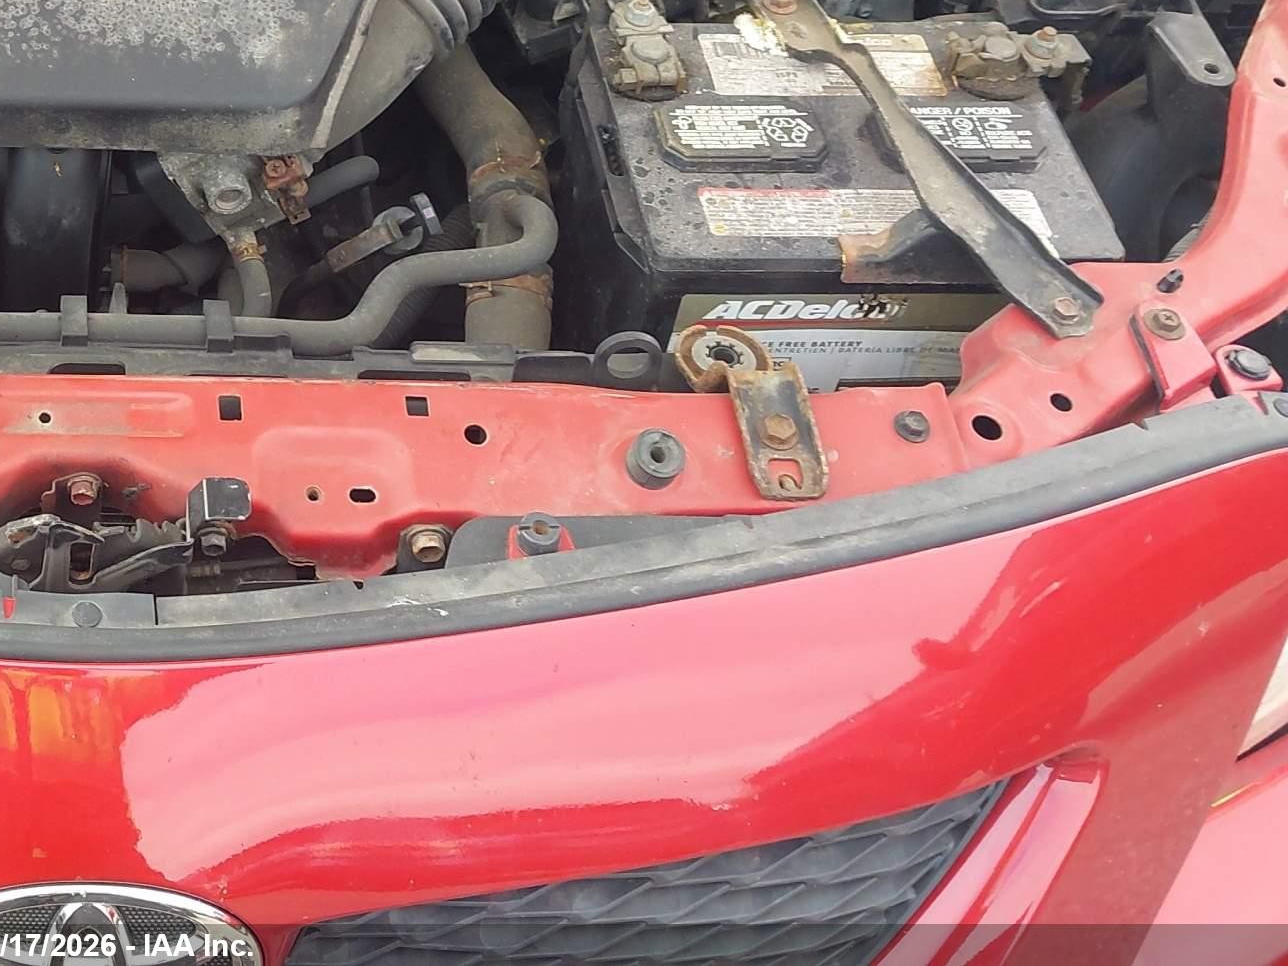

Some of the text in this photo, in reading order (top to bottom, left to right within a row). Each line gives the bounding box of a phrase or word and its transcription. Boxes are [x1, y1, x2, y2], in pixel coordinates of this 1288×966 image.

[910, 107, 952, 115] ANGER
[963, 107, 1012, 115] POISON
[811, 340, 863, 348] BATTERY
